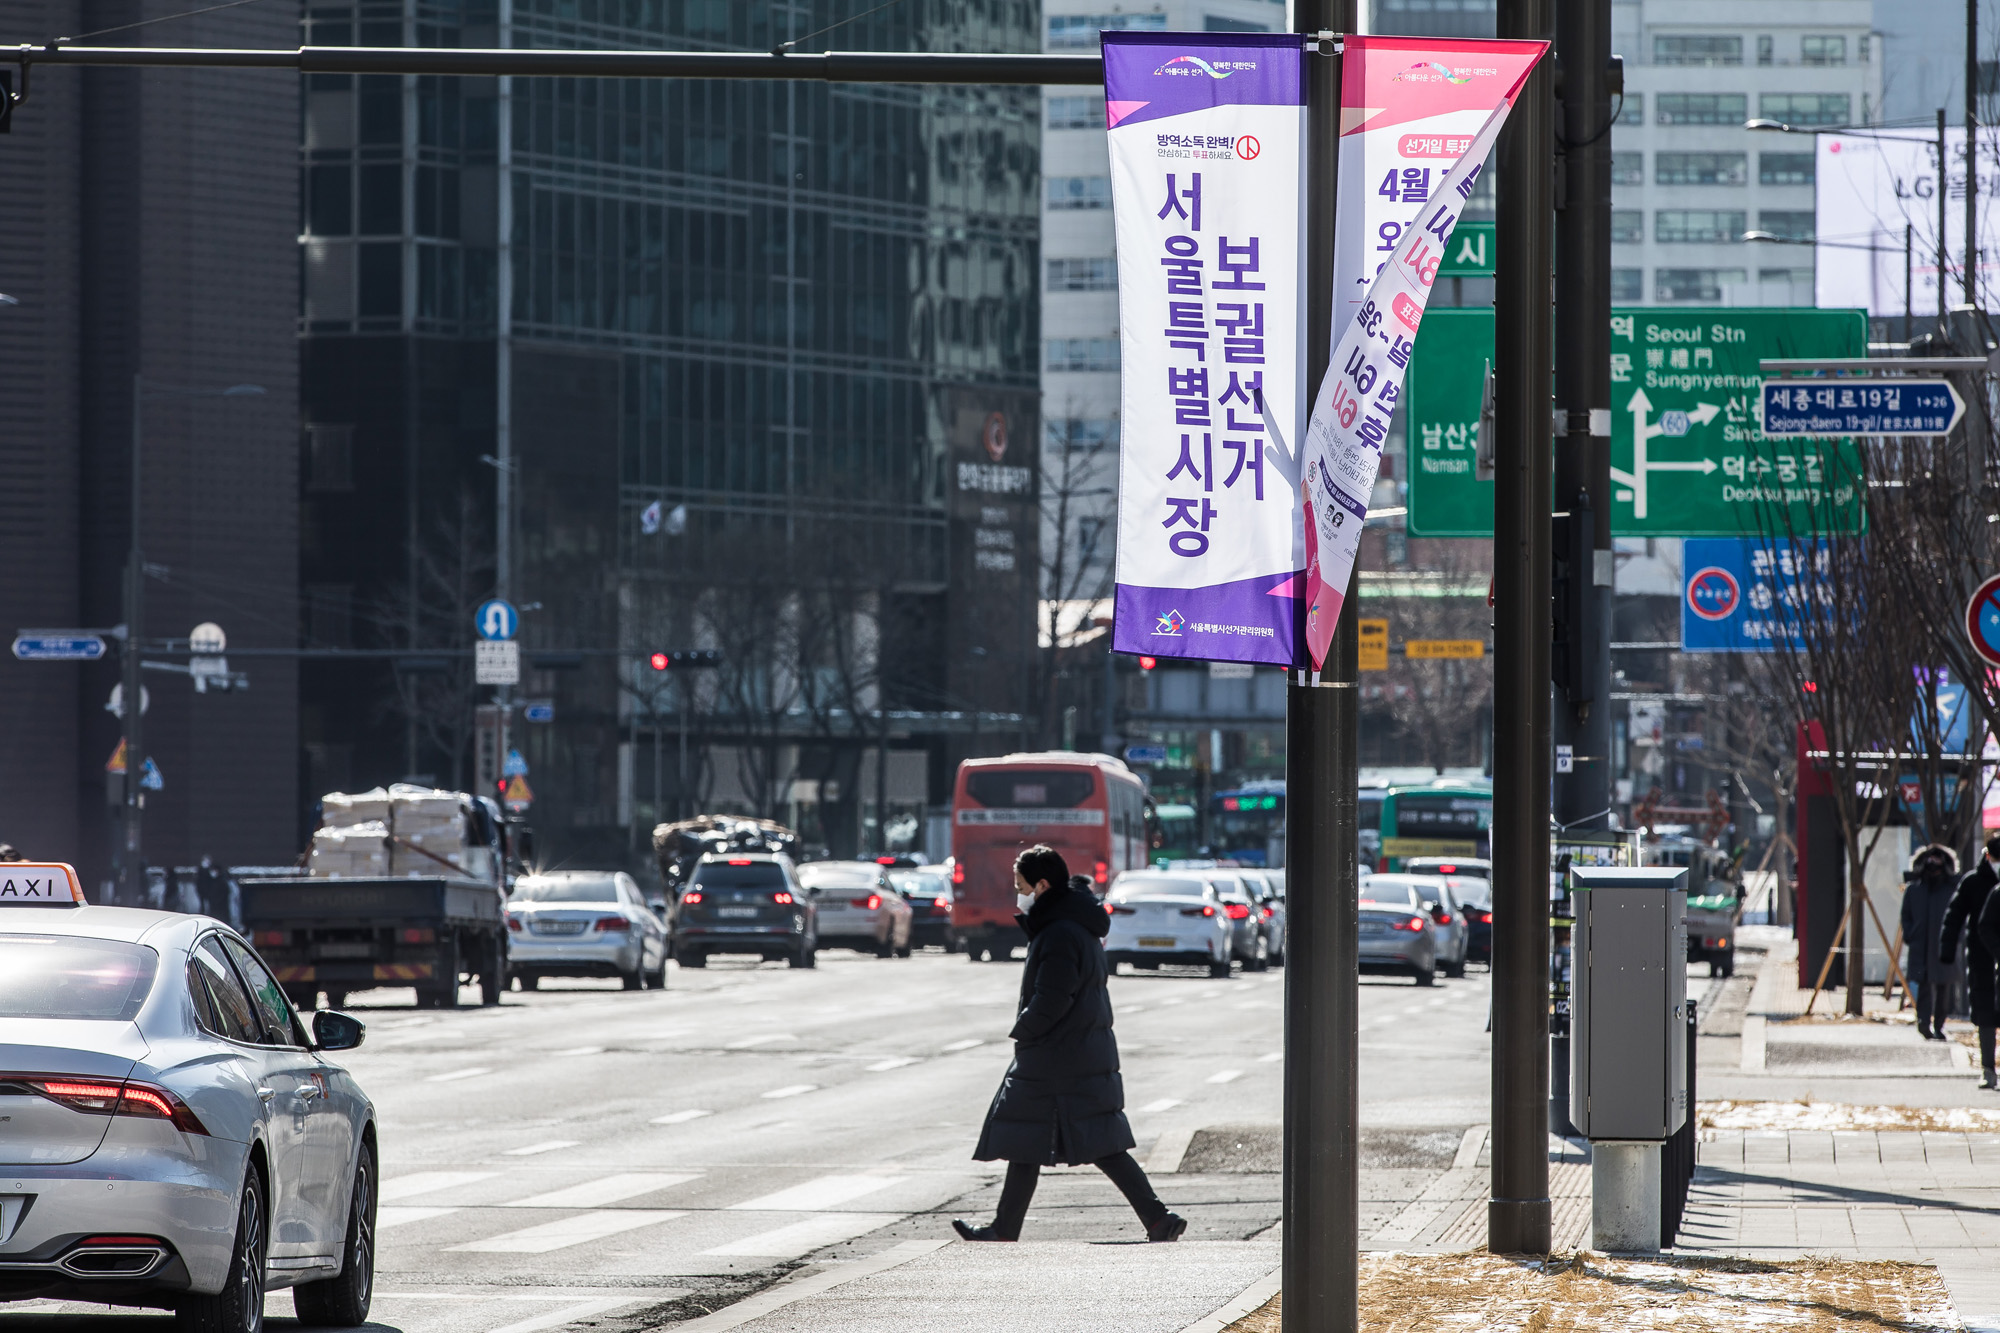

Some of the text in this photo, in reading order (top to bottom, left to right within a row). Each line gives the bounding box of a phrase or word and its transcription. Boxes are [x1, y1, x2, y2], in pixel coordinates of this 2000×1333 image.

[1165, 67, 1203, 77] 아름다운 선거
[1232, 62, 1256, 70] 대한민국
[1473, 68, 1497, 76] 대한민국
[1405, 73, 1443, 83] 아름다운 선거
[1157, 134, 1235, 149] 방역소독 완벽!
[1405, 138, 1443, 154] 선거일
[1157, 148, 1234, 160] 안심하고 투표하세요.
[1378, 168, 1430, 203] 4월
[1645, 324, 1745, 343] Seoul Stn
[1157, 172, 1218, 558] 서울특별시장
[1212, 236, 1265, 501] 보궐선거
[1645, 370, 1761, 392] Sungnyemun
[1770, 388, 1901, 411] 세종대로19길
[1769, 415, 1843, 432] Sejong-daero
[1421, 456, 1470, 475] Namsan
[1722, 454, 1824, 483] 덕수궁길
[1190, 622, 1274, 638] 서울특별시선거관리위원회
